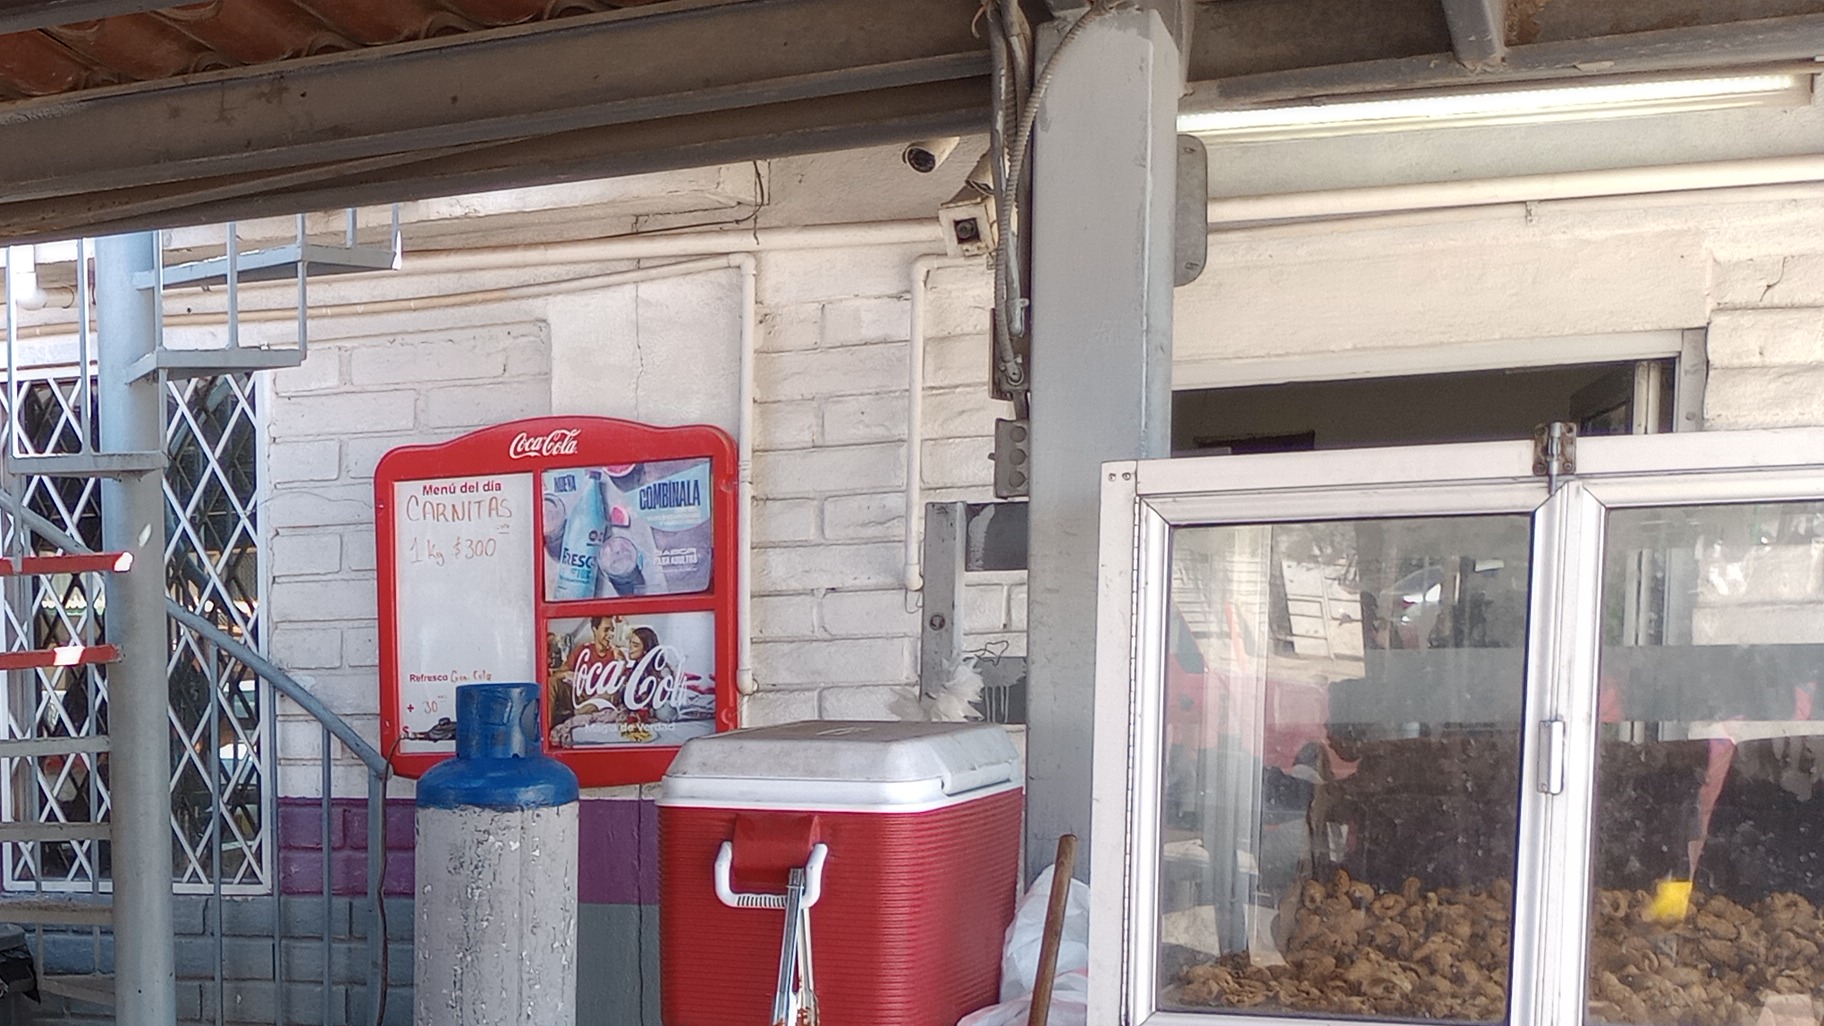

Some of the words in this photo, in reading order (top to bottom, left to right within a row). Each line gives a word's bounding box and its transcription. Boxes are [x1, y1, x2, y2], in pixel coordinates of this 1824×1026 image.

[509, 429, 582, 459] Coca-Cola
[422, 483, 456, 496] Menú
[460, 482, 479, 493] del
[482, 481, 502, 492] día
[406, 495, 513, 522] CARNITAS
[572, 645, 689, 712] Coca-Cola
